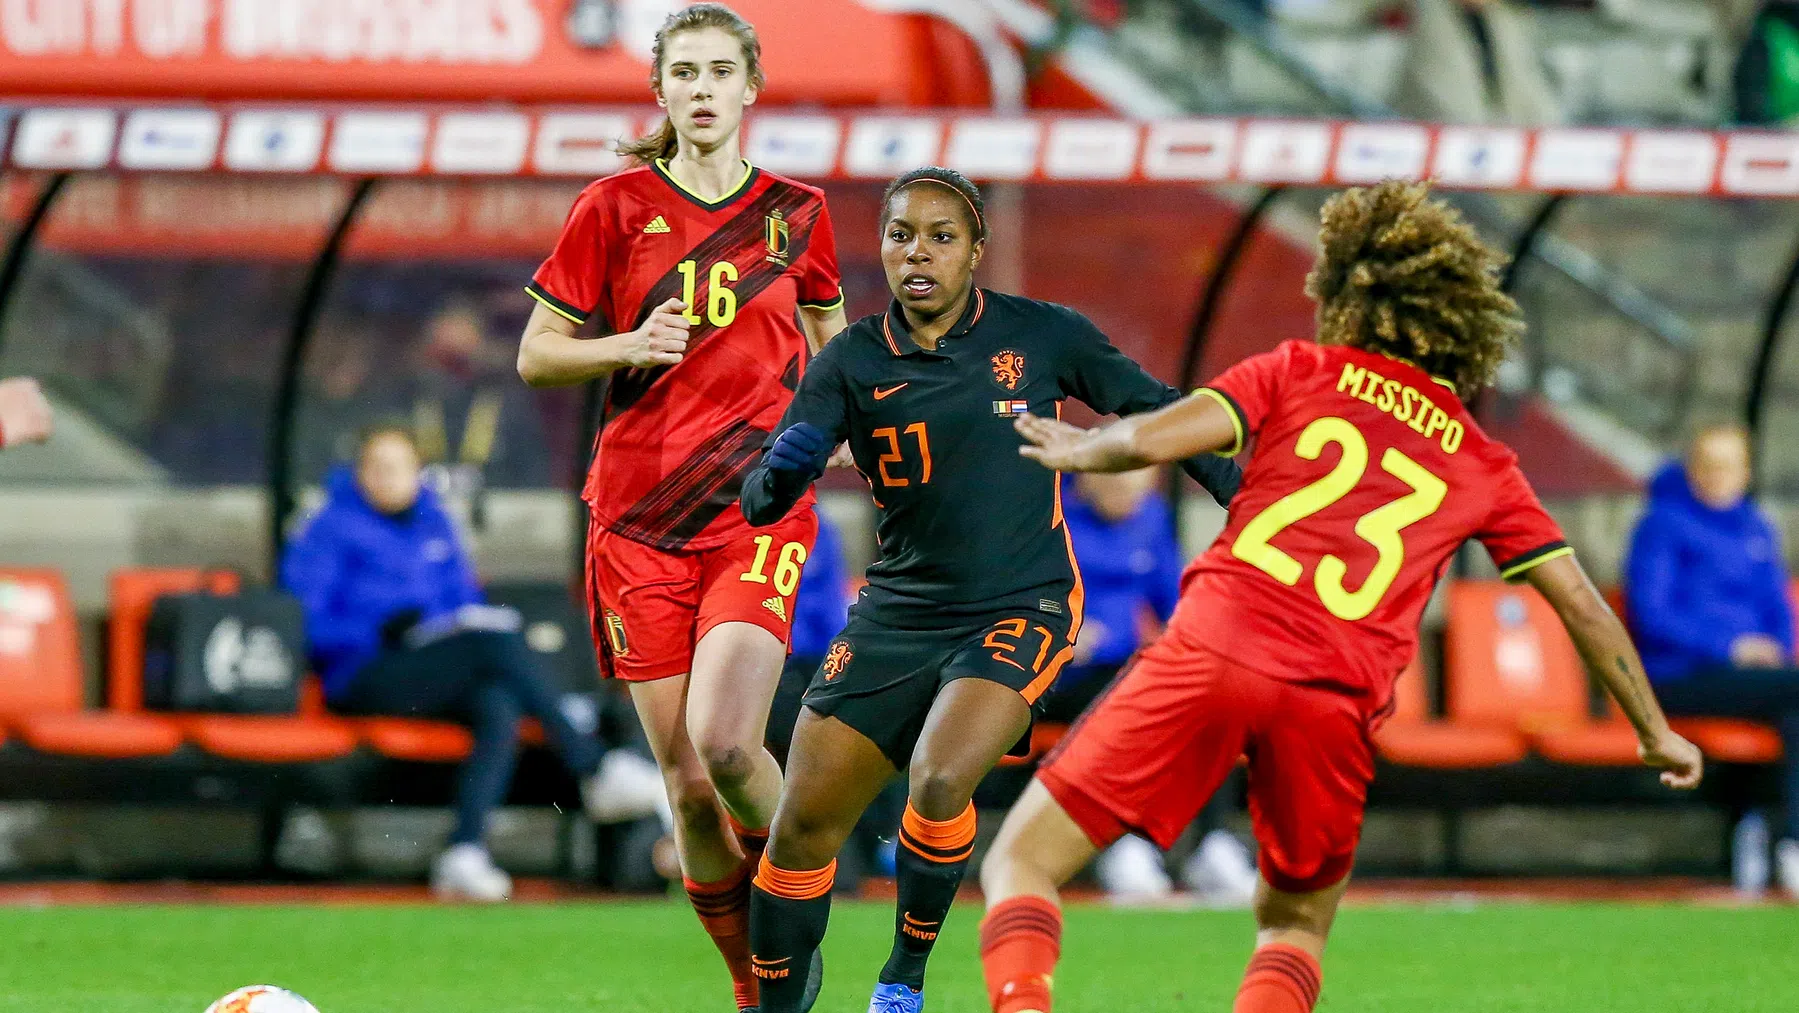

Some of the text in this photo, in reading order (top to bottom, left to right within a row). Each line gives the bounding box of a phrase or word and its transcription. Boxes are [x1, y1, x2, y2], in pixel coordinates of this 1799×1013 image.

[677, 259, 739, 328] 16
[1336, 362, 1465, 455] MISSIPO
[872, 421, 933, 487] 21
[1231, 416, 1449, 621] 23
[739, 534, 808, 597] 16
[982, 617, 1053, 674] 21
